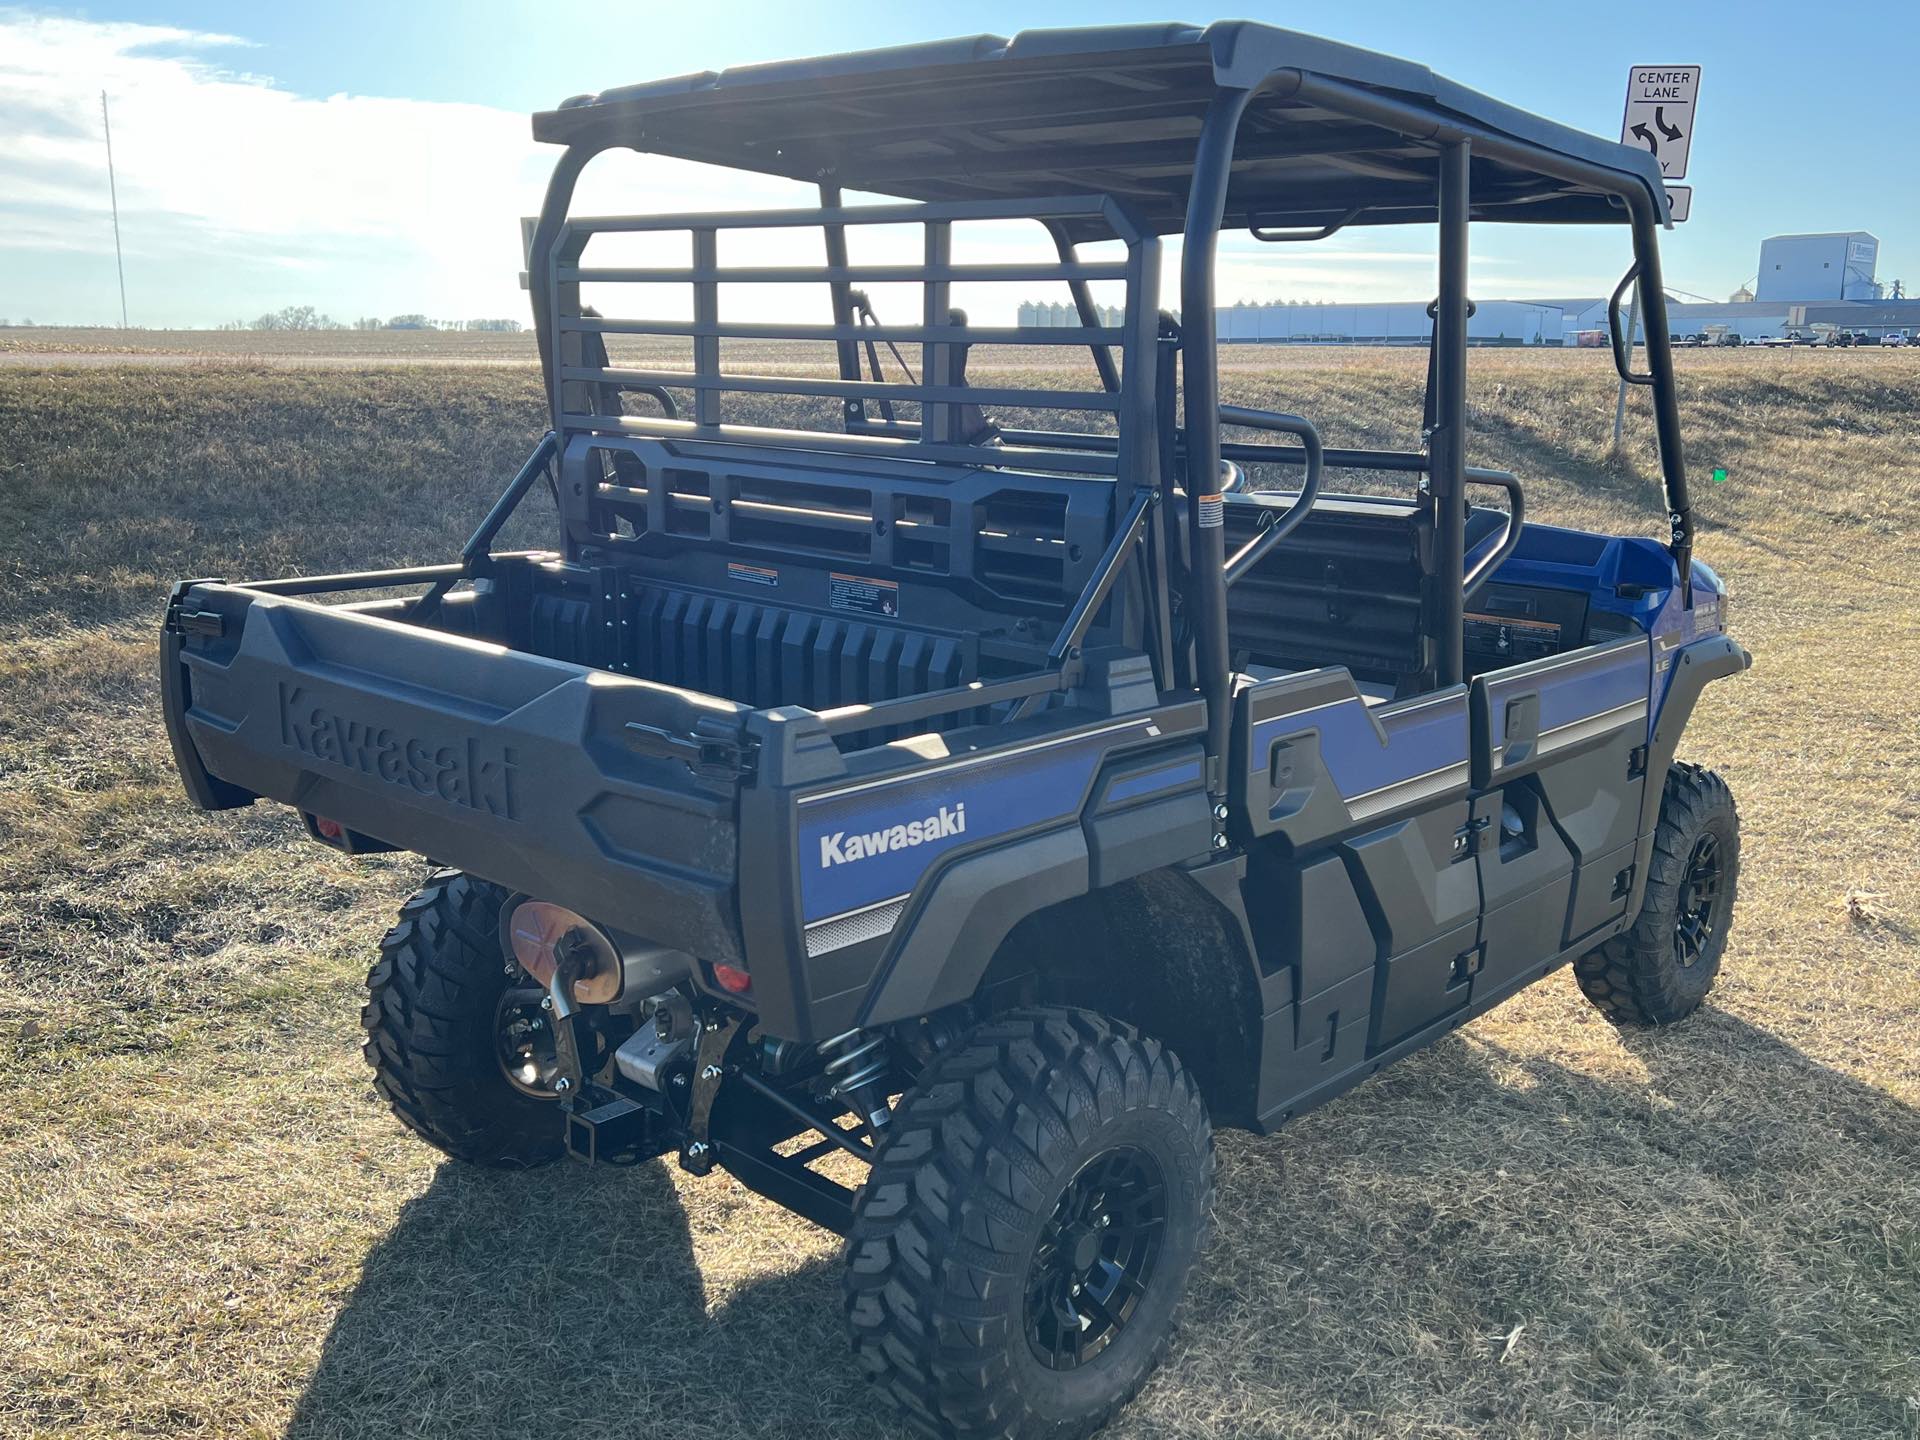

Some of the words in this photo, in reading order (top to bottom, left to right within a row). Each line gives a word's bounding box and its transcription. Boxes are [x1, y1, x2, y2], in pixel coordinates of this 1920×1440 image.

[1638, 73, 1690, 84] CENTER
[1644, 87, 1680, 98] LANE
[279, 681, 520, 823] Kawasaki
[820, 801, 966, 868] Kawasaki
